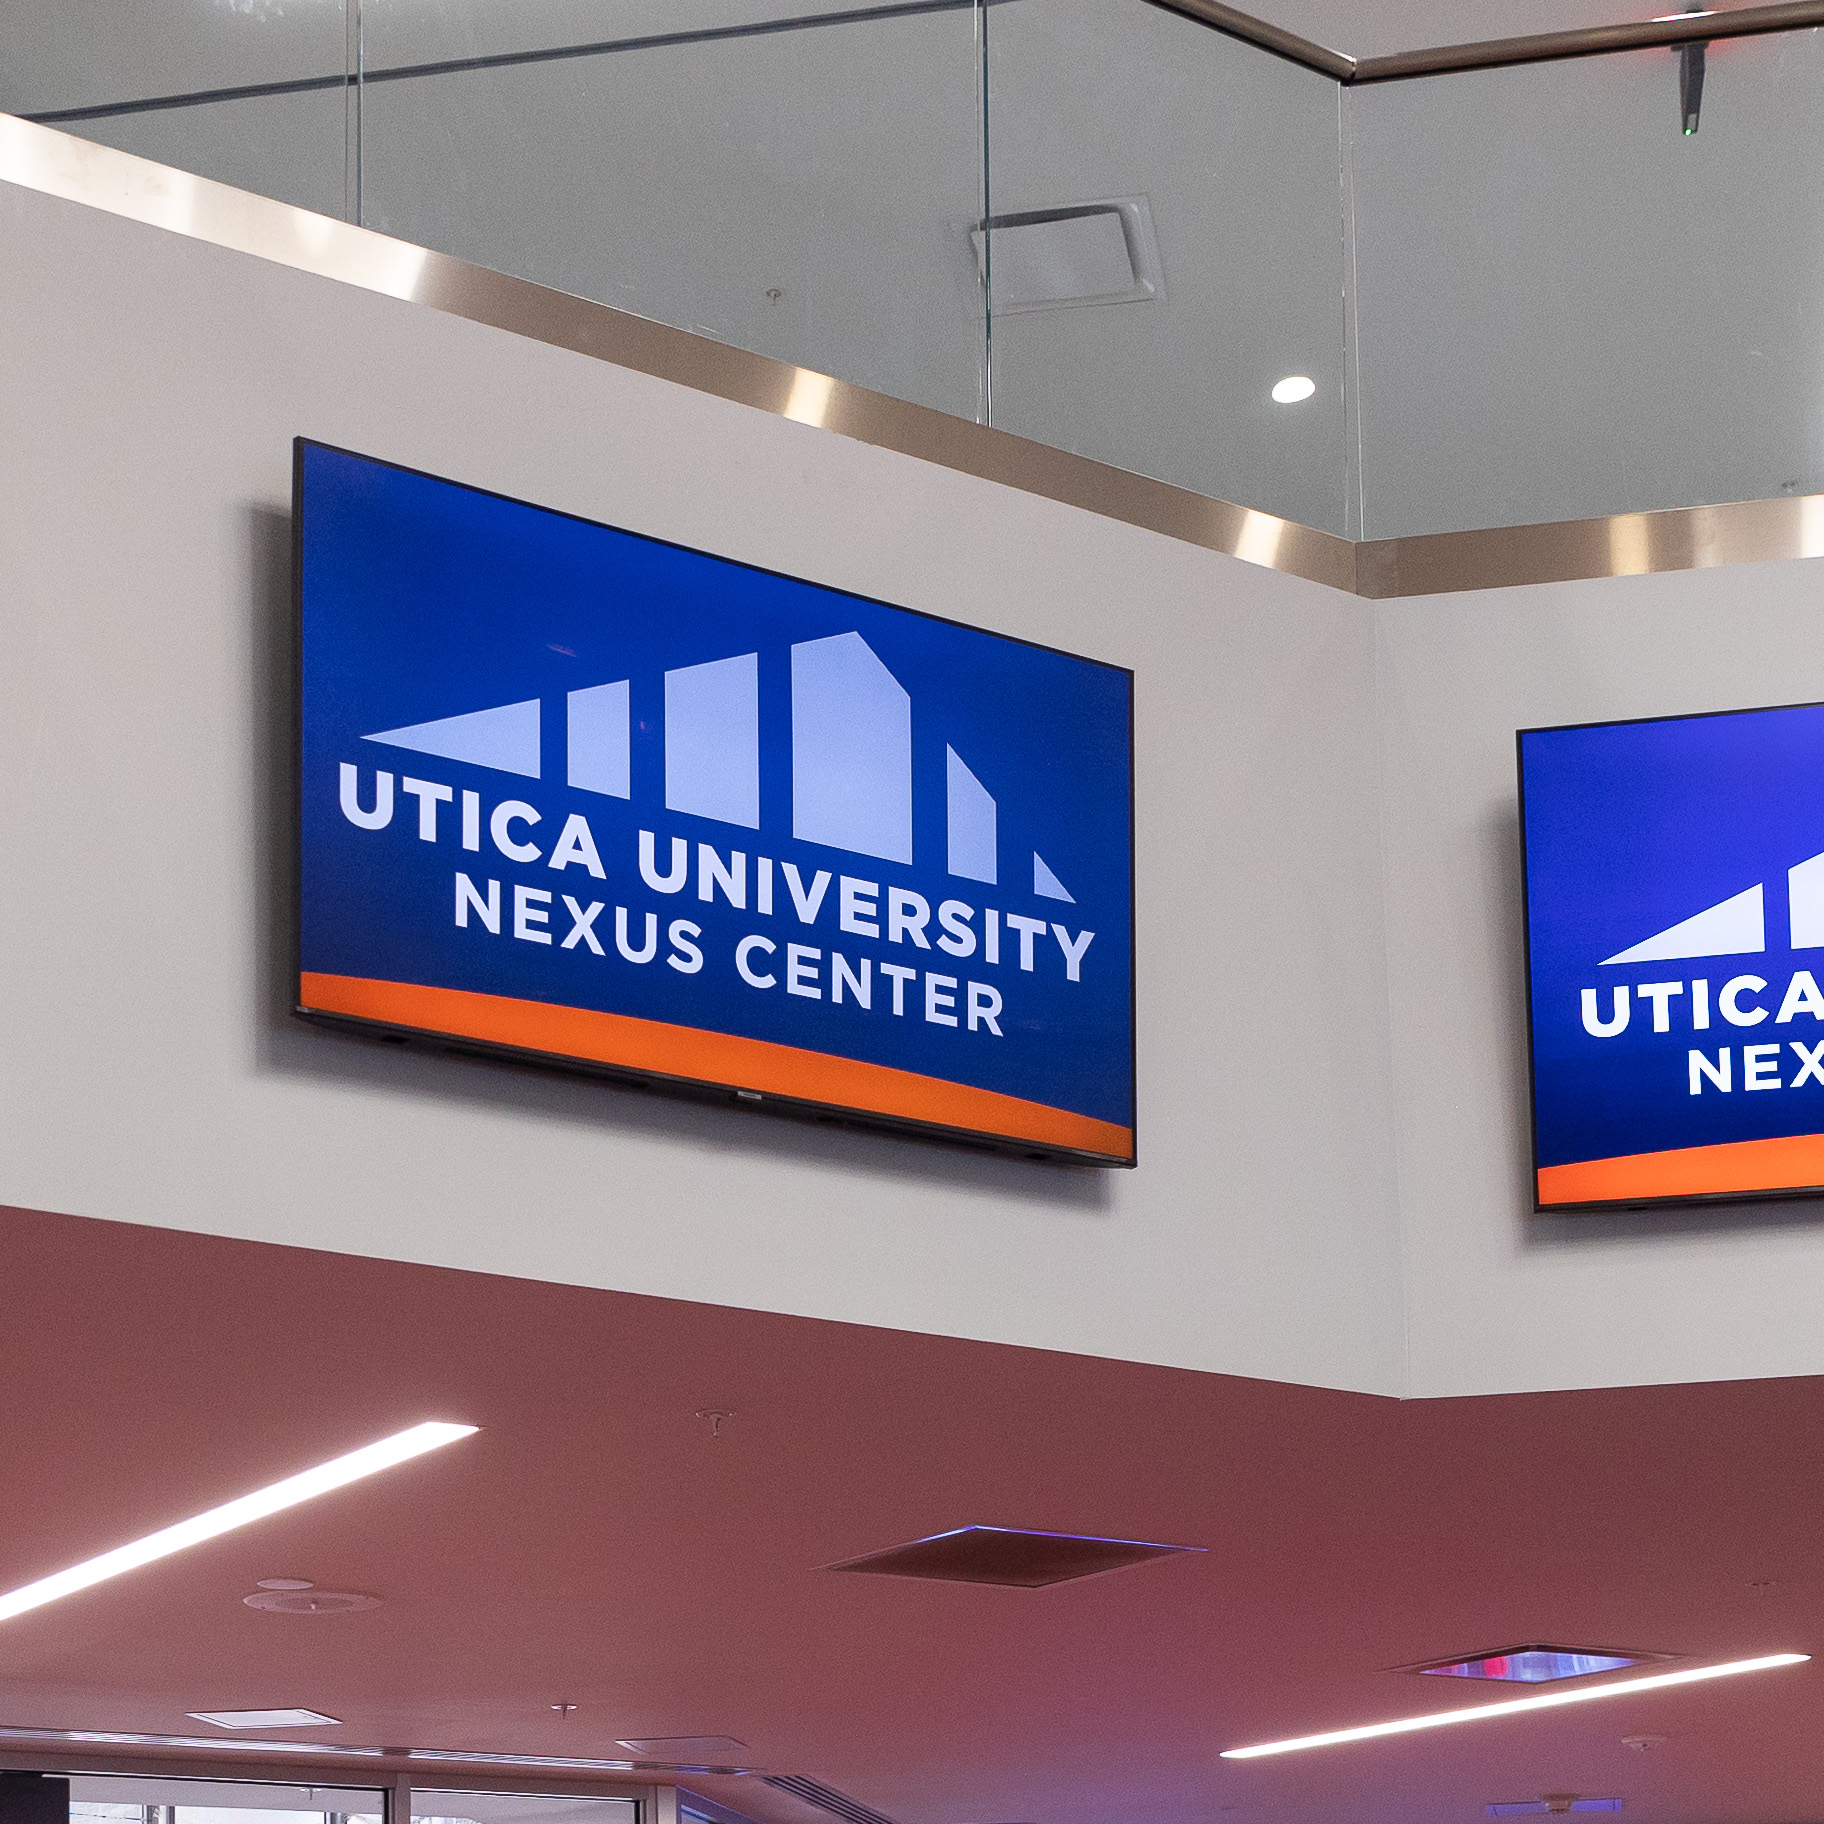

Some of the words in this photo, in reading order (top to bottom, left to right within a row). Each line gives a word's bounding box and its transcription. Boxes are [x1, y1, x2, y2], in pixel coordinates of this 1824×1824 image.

[338, 761, 607, 881] UTICA
[638, 829, 1097, 984] UNIVERSITY
[454, 871, 705, 976] NEXUS
[735, 934, 1005, 1039] CENTER
